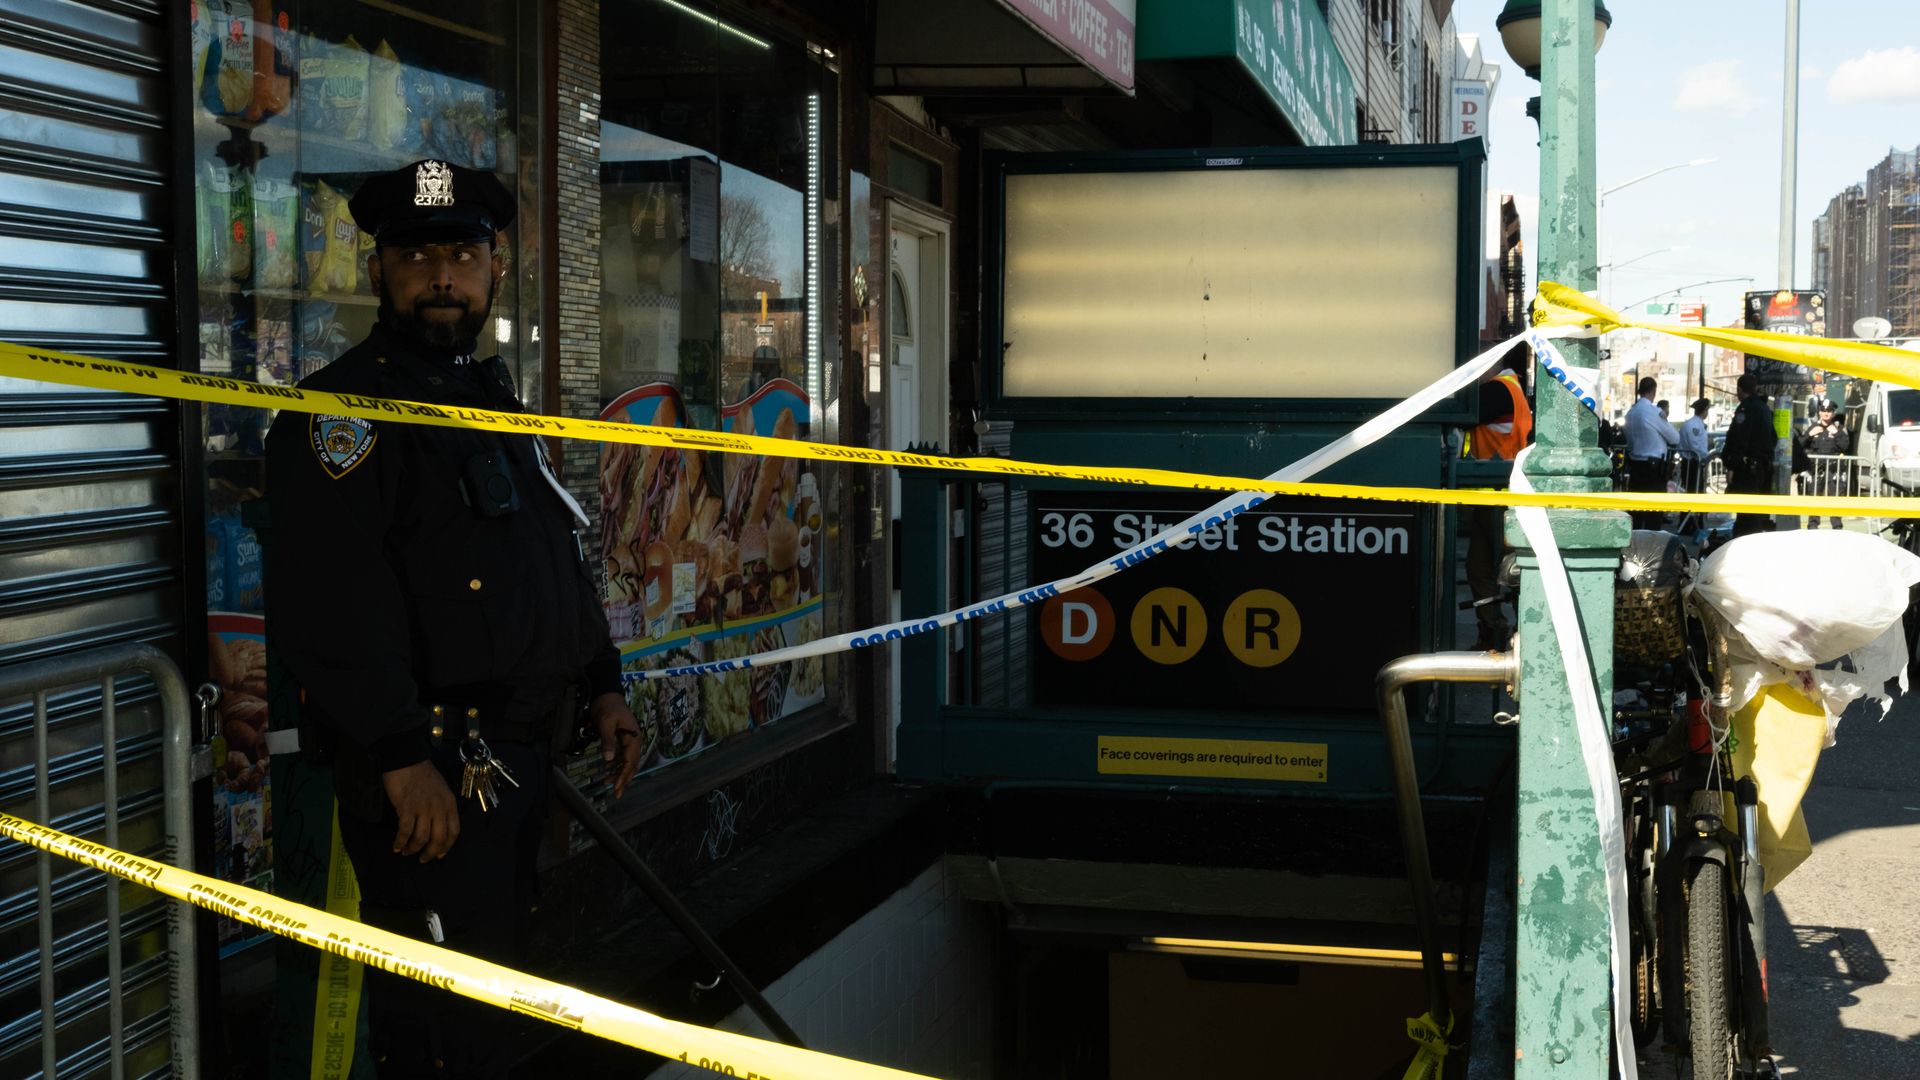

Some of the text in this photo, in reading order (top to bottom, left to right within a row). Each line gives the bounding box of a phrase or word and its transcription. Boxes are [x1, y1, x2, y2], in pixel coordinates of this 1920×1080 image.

[1069, 0, 1133, 79] COFFEE TEA
[316, 414, 374, 431] DEPARTMENT
[313, 431, 331, 464] CITY OF
[341, 435, 374, 469] NEW YORK
[808, 446, 883, 461] CROSS
[1040, 512, 1095, 549] 36
[1257, 516, 1410, 555] Station
[1109, 539, 1169, 572] LINE
[1061, 602, 1098, 645] D
[1151, 605, 1187, 647] N
[1245, 607, 1281, 650] R
[1101, 747, 1324, 767] Face coverings are required to enter
[0, 813, 104, 868] 00-577-TIPS
[186, 883, 248, 919] CRIME
[248, 905, 308, 942] SCENE
[323, 931, 352, 960] DO
[353, 942, 396, 970] NOT
